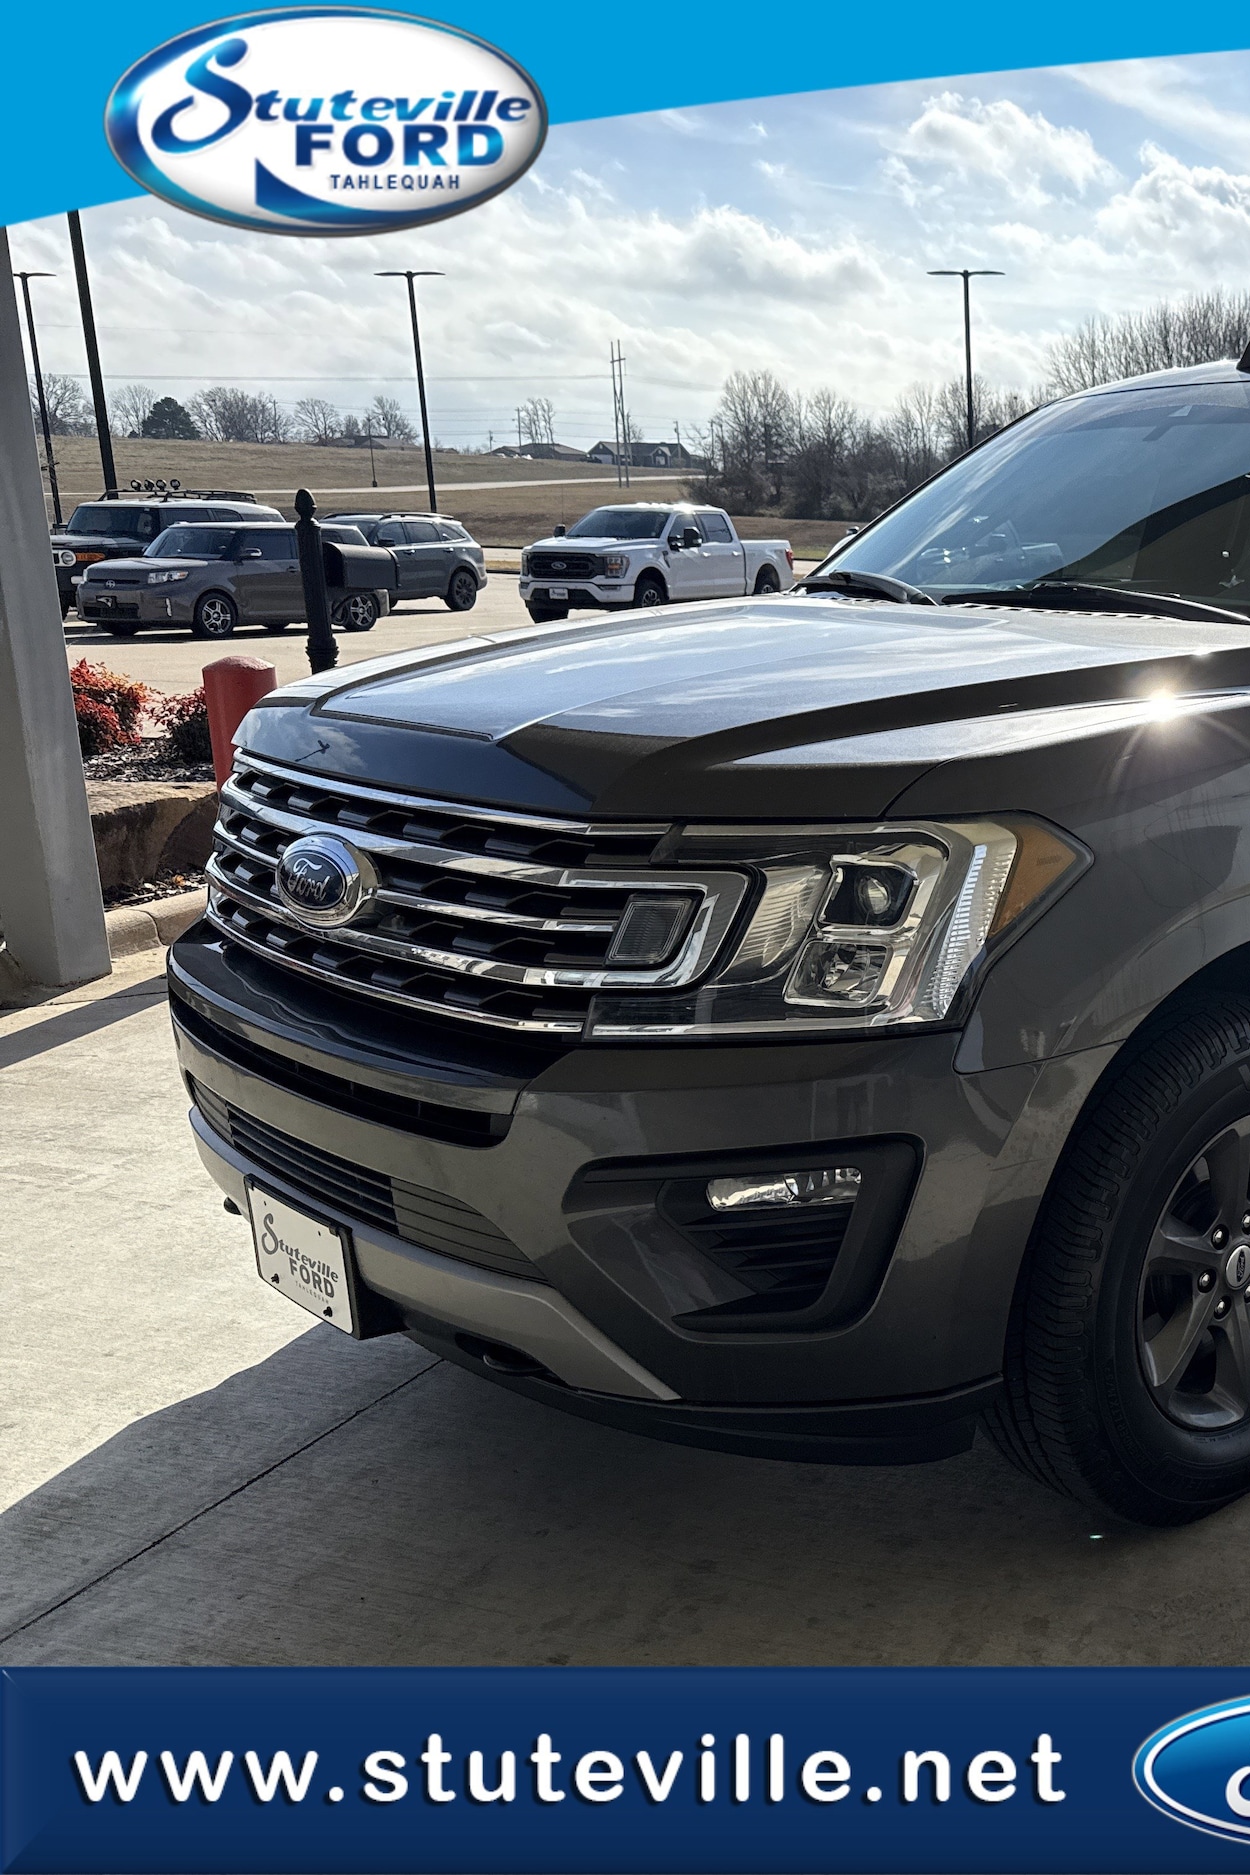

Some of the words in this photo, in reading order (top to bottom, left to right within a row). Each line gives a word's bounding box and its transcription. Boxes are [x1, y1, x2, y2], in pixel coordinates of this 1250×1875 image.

[287, 857, 331, 901] Ford
[261, 1213, 339, 1283] Stuteville
[289, 1257, 335, 1299] FORD
